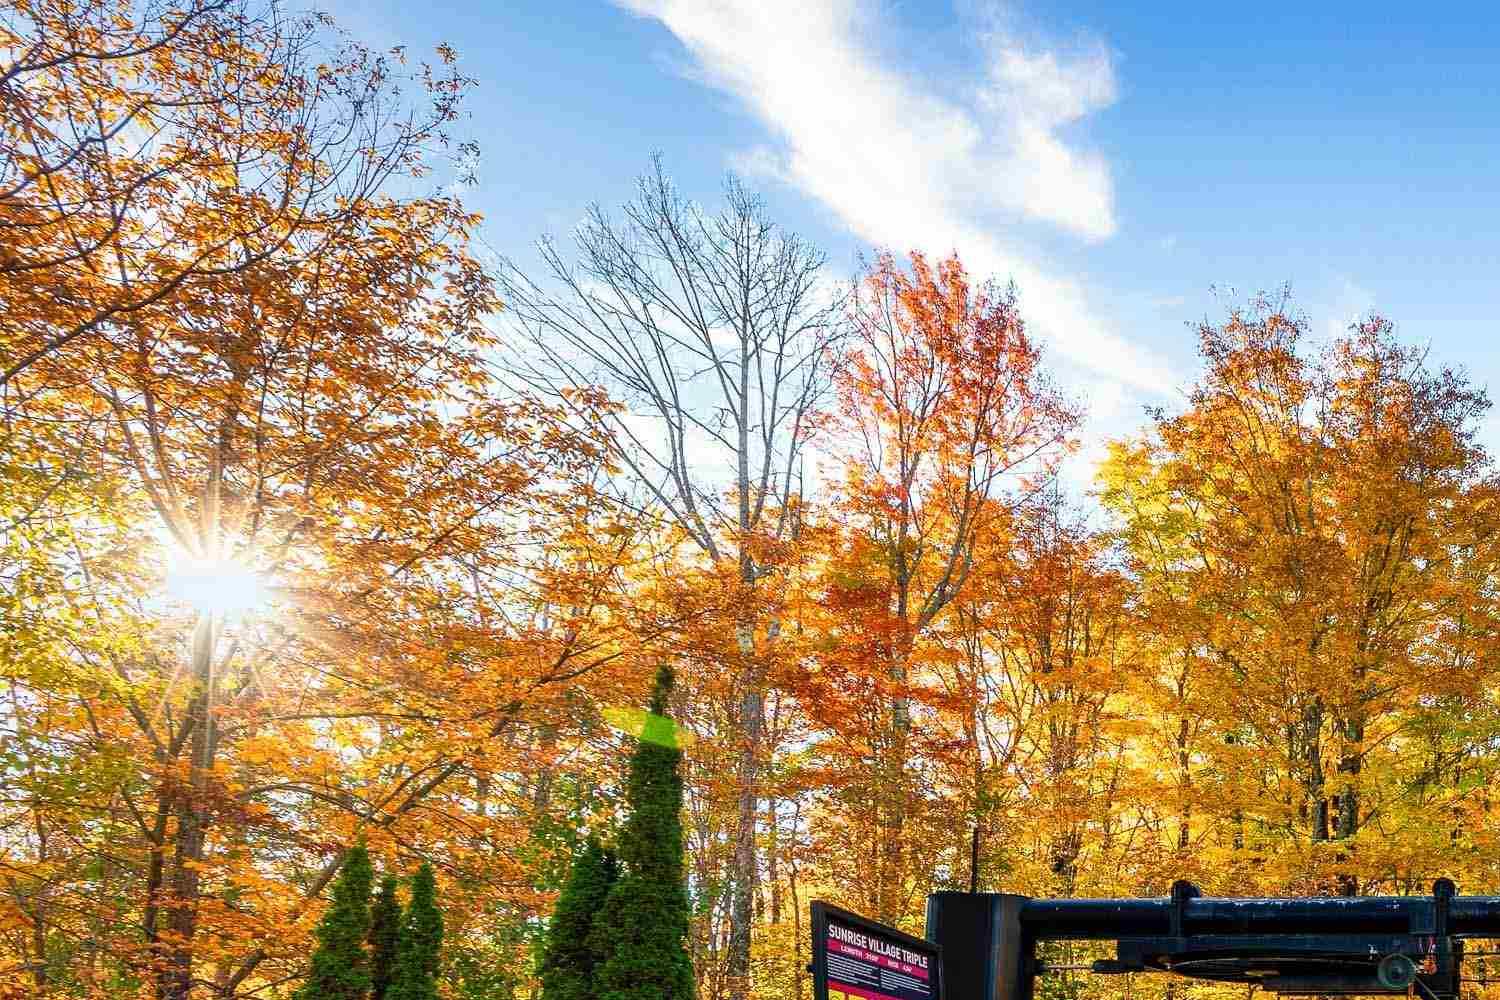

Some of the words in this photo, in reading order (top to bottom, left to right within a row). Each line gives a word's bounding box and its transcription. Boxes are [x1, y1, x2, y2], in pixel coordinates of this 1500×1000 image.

[828, 924, 868, 948] SUNRISE
[868, 936, 901, 959] VILLAGE
[901, 949, 928, 969] TRIPLE
